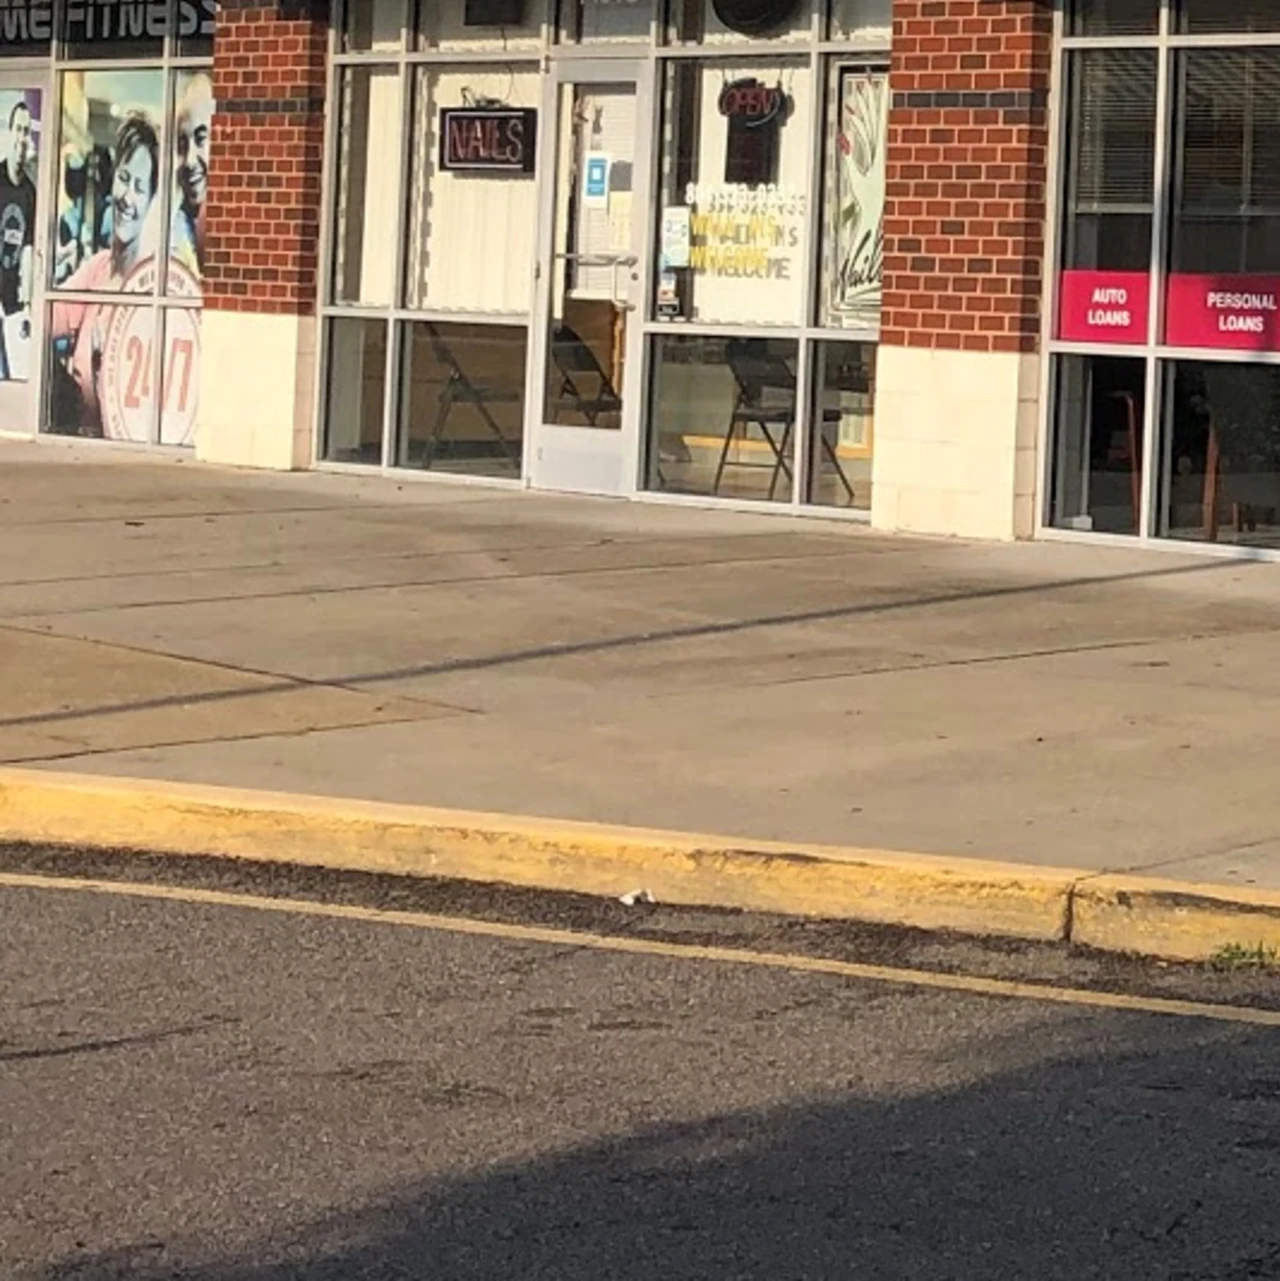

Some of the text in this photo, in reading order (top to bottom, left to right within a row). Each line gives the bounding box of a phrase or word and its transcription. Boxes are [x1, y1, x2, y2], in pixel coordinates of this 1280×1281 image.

[449, 118, 524, 163] NAILS
[1091, 287, 1128, 304] AUTO
[1206, 291, 1278, 311] PERSONAL
[1087, 308, 1132, 326] LOANS
[1218, 314, 1265, 333] LOANS
[125, 334, 194, 414] 2/7
